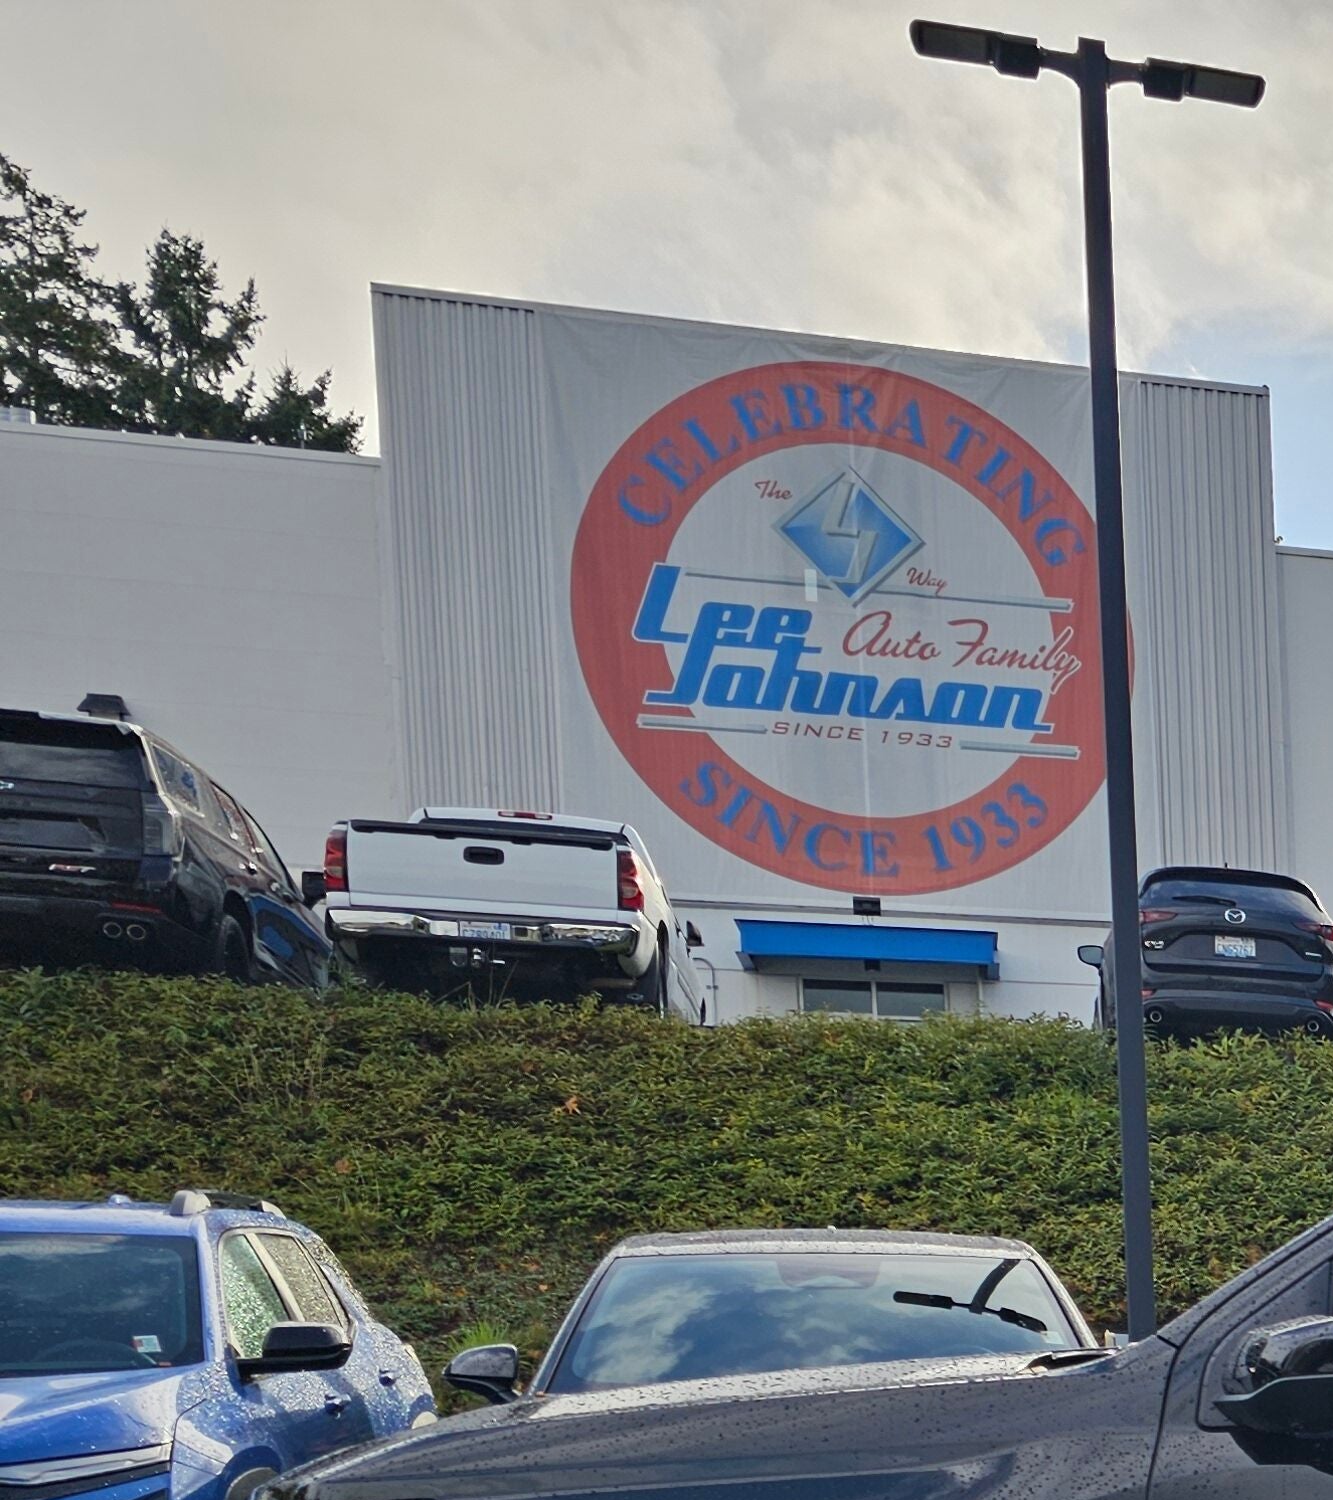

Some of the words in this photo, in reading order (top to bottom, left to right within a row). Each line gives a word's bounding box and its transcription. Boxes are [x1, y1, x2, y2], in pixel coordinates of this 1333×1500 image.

[618, 384, 1086, 567] CELEBRATING
[754, 480, 793, 501] The
[632, 564, 822, 656] Lee
[906, 567, 948, 597] Way
[643, 637, 1053, 733] Johnson
[842, 610, 942, 662] Auto
[946, 618, 1081, 694] Family
[771, 721, 865, 742] SINCE
[880, 730, 954, 750] 1933
[679, 761, 899, 878] SINCE
[922, 782, 1049, 873] 1933
